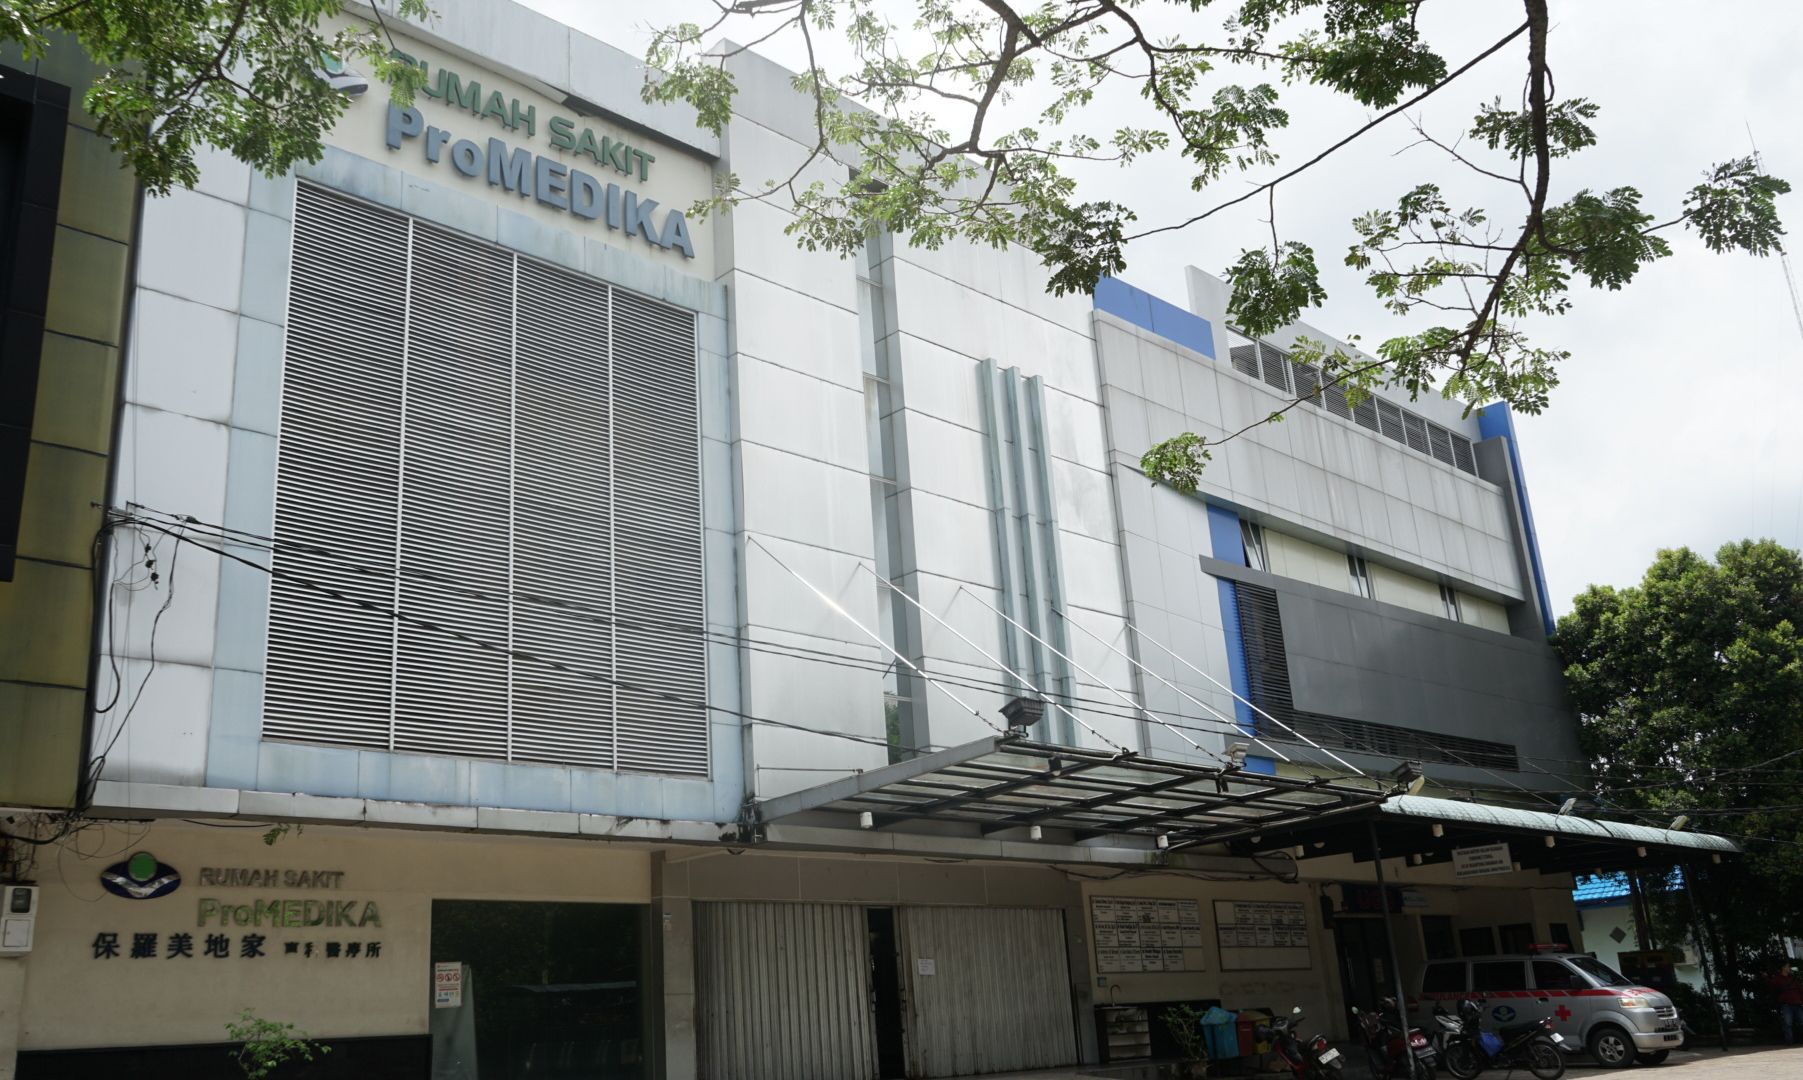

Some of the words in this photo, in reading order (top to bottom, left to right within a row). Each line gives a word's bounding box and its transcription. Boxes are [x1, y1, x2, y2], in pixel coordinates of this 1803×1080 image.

[549, 115, 656, 182] SAKIT
[385, 99, 696, 259] ProMEDIKA
[200, 867, 279, 888] RUMAH
[284, 869, 345, 889] SAKIT
[197, 898, 383, 928] ProMEDIKA
